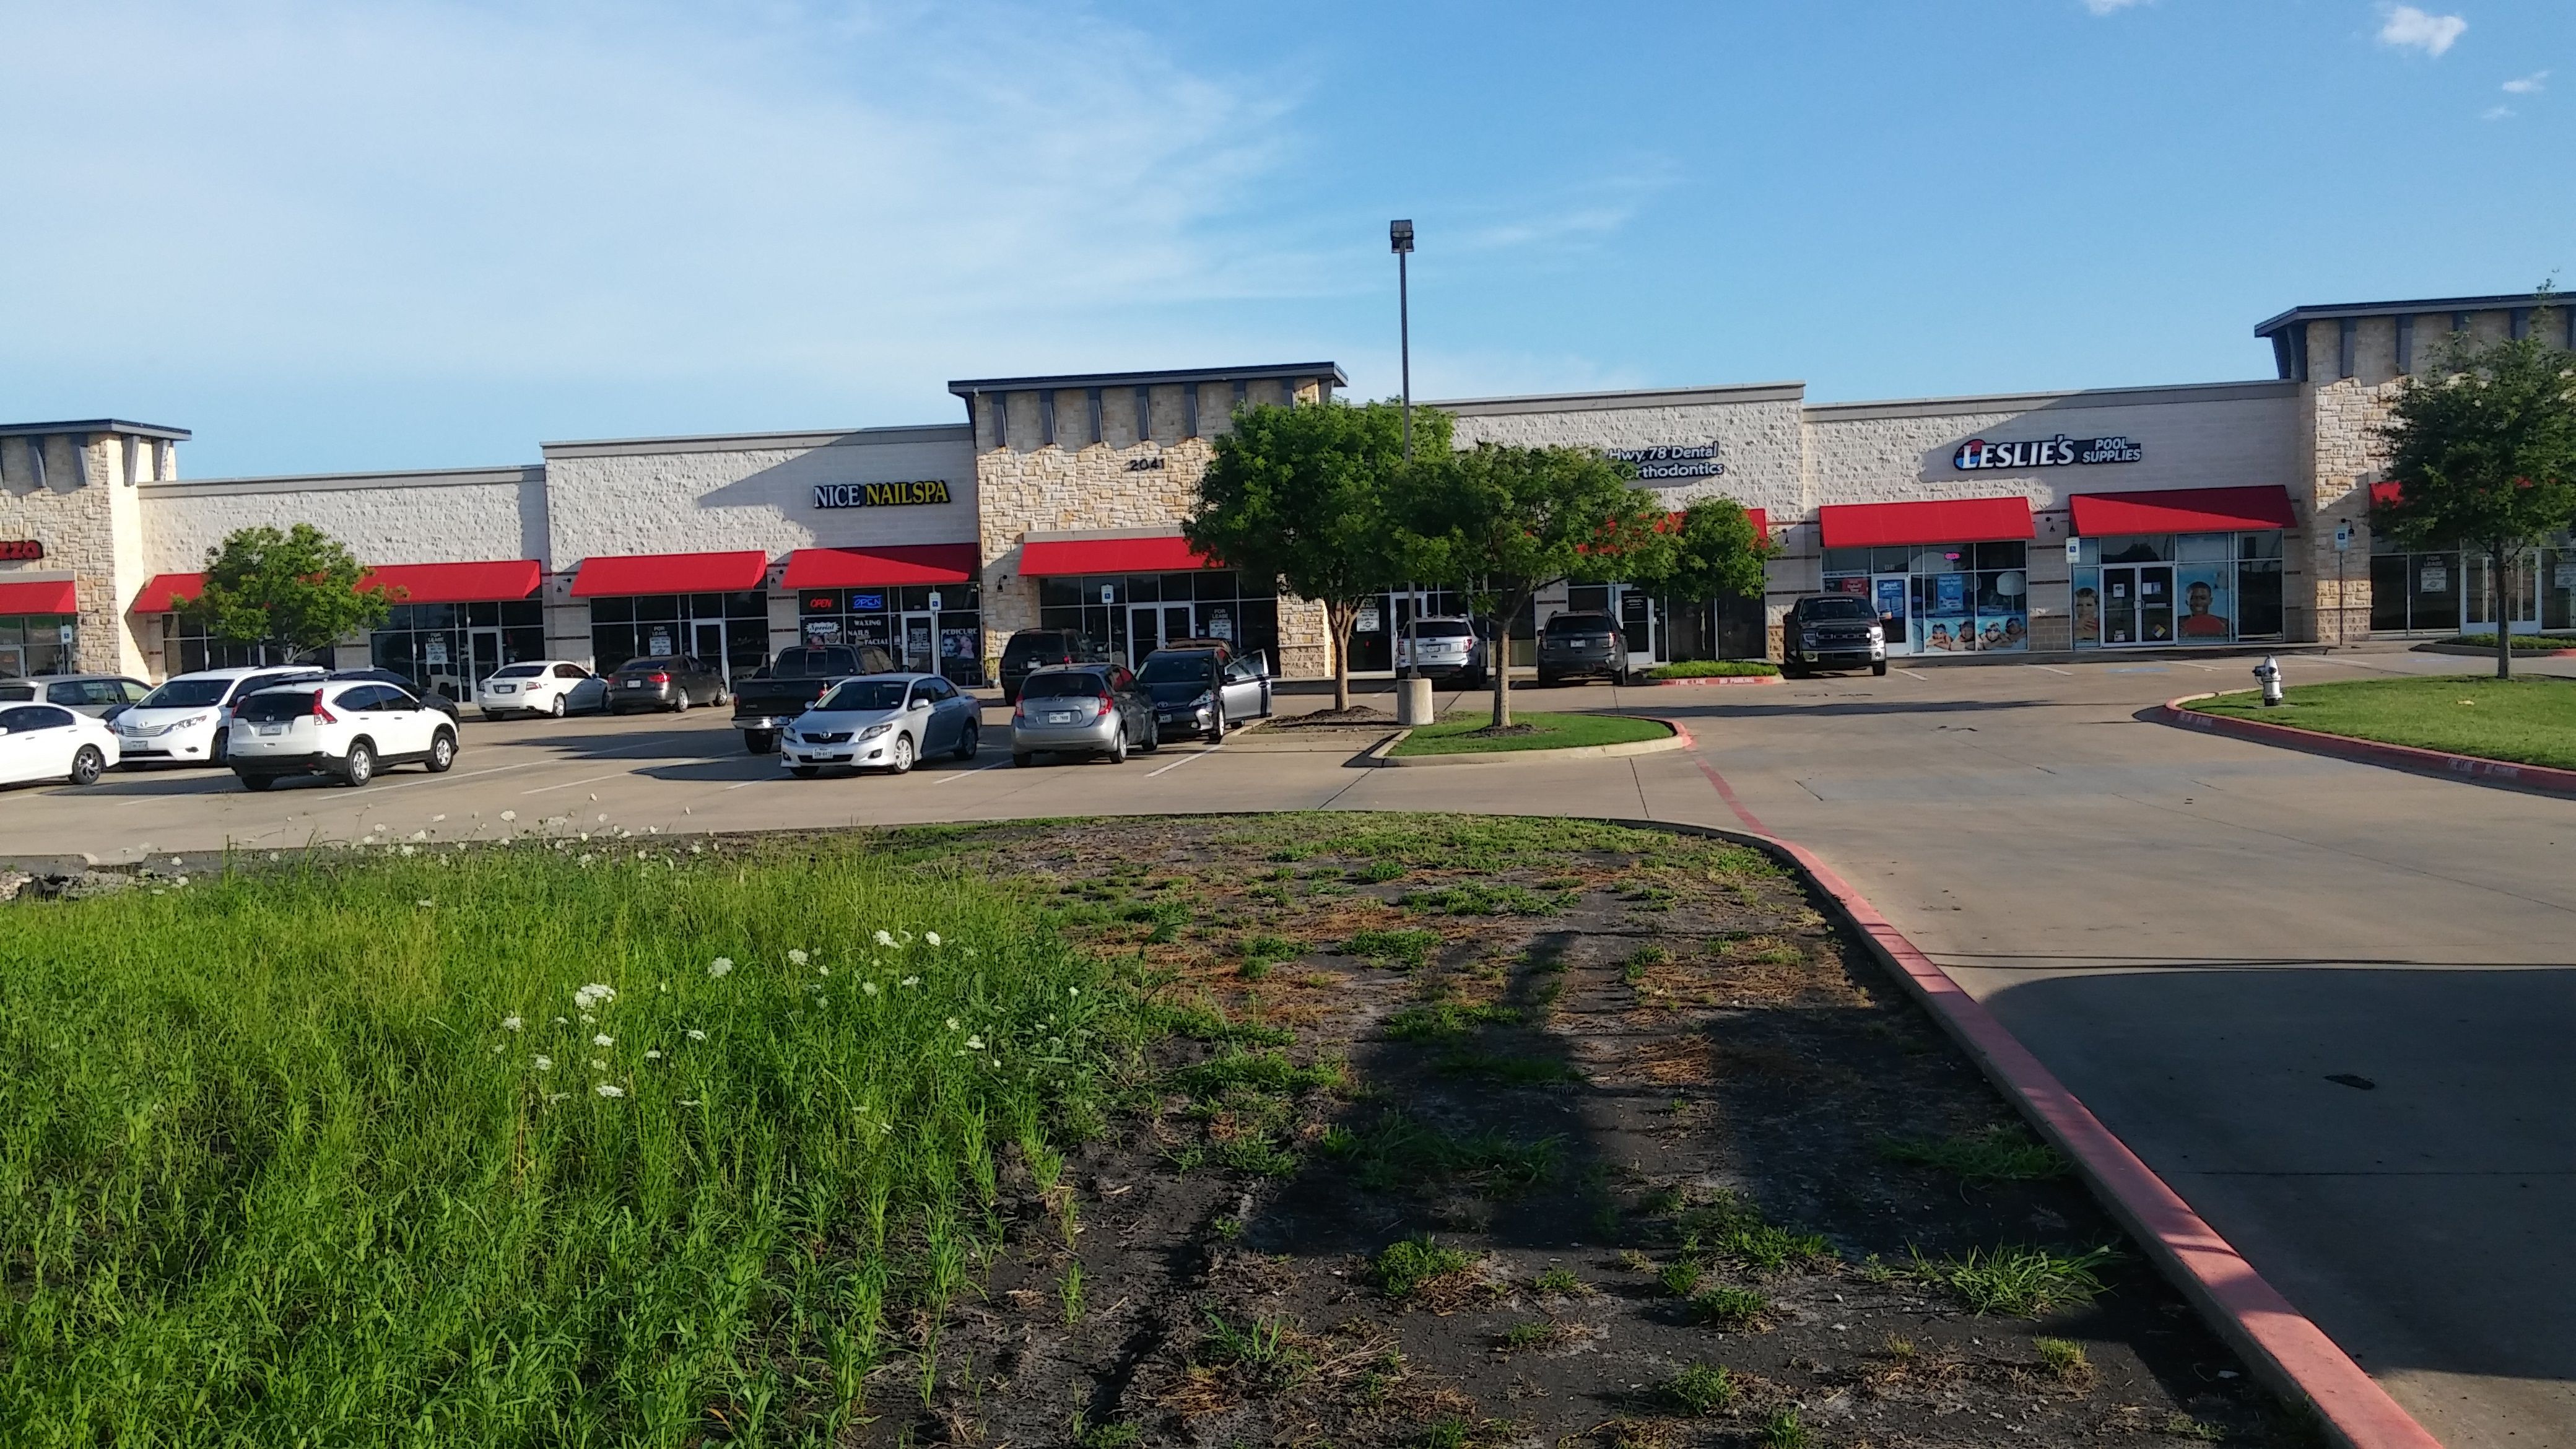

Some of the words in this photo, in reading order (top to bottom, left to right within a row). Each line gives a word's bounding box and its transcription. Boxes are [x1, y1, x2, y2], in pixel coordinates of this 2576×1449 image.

[1648, 446, 1668, 460] 78
[1672, 442, 1718, 459] Dental
[1962, 434, 2074, 469] LESLIE'S
[2095, 438, 2128, 451] POOL
[2082, 448, 2141, 463] SUPPLIES
[1129, 456, 1165, 471] 2041
[814, 484, 860, 508] NICE
[810, 599, 833, 607] OPEN
[854, 598, 881, 606] OPEN
[809, 624, 835, 632] Special
